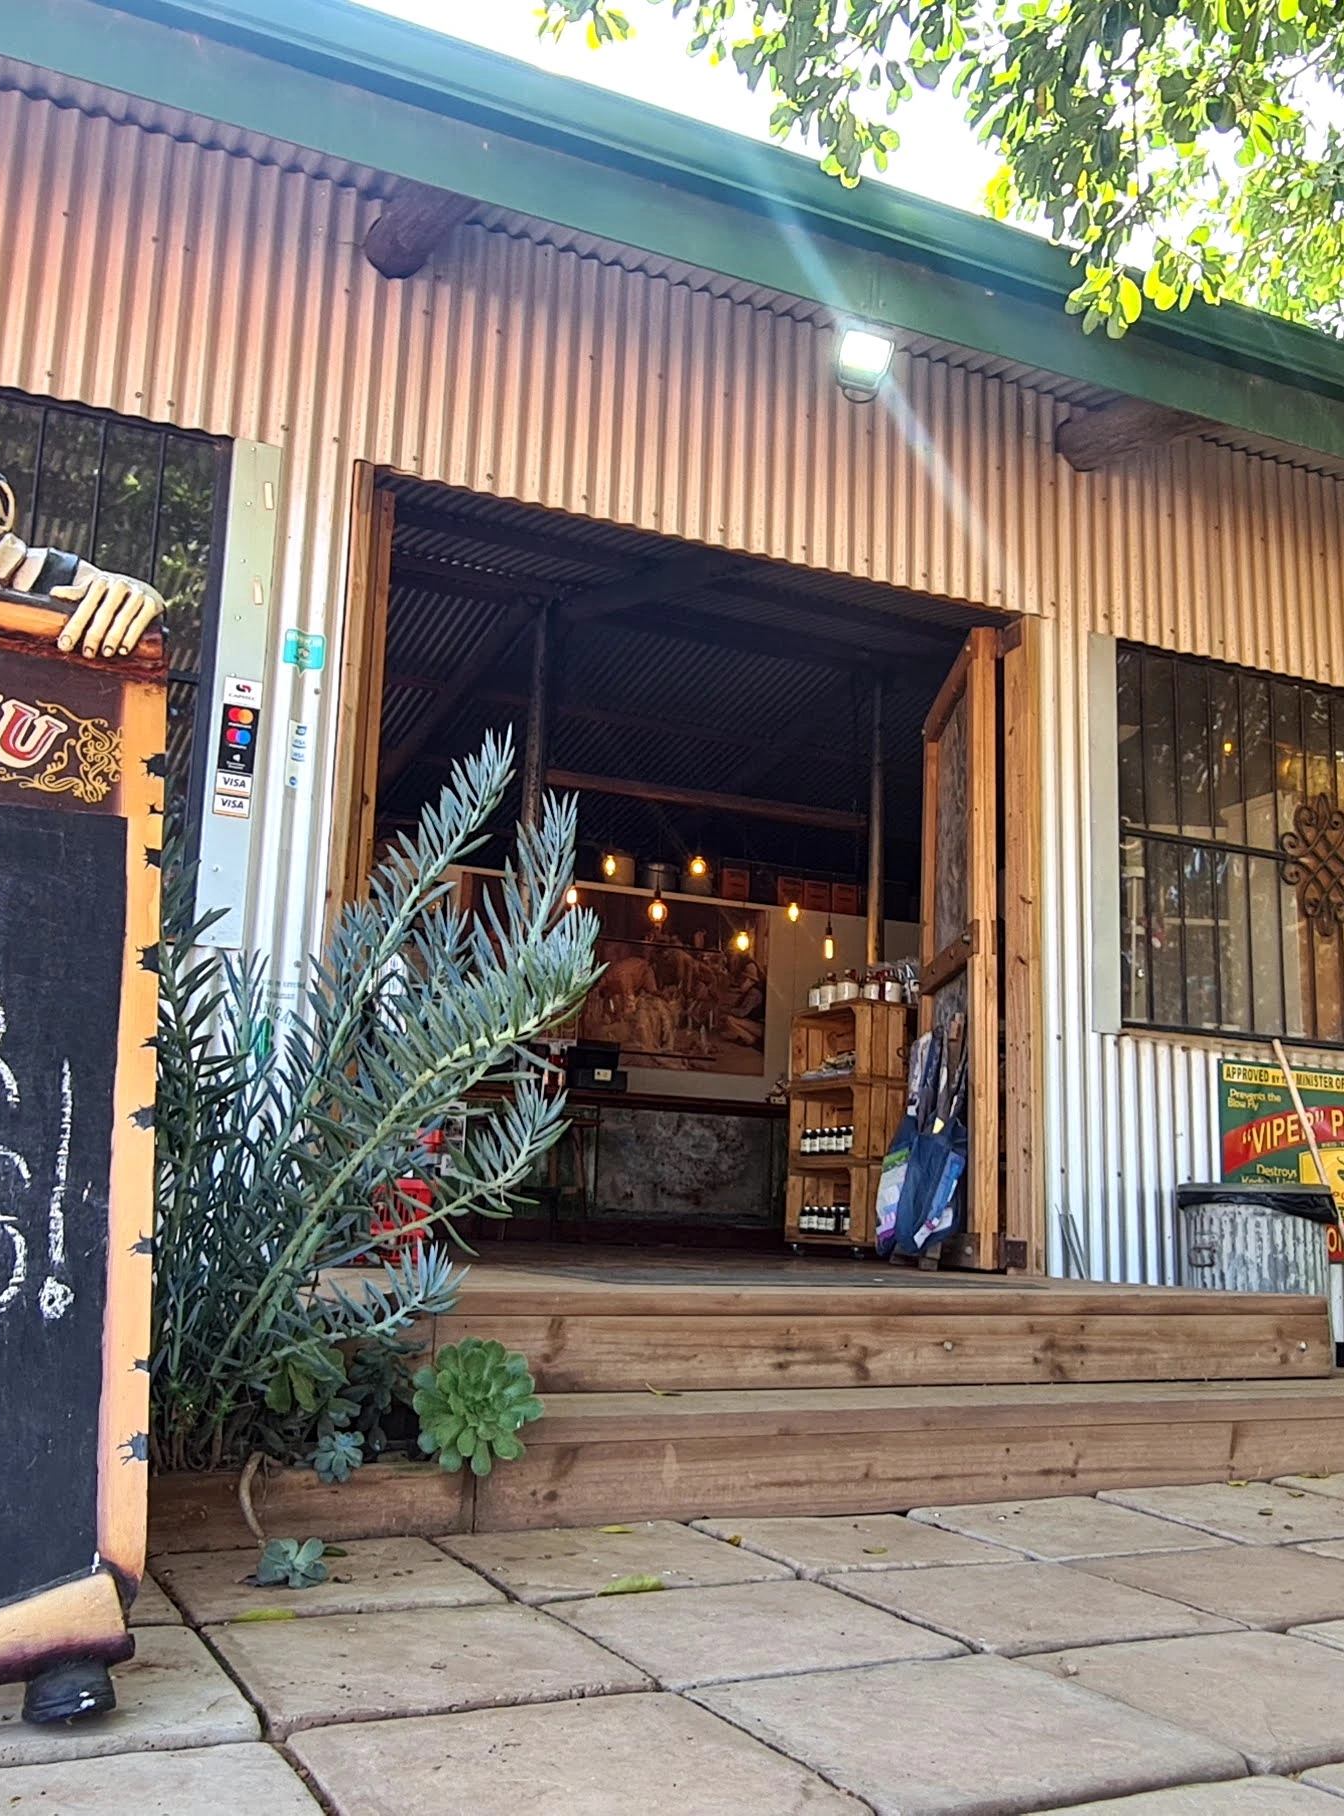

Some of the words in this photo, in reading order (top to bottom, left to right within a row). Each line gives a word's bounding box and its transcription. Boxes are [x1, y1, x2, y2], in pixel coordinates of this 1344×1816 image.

[223, 776, 246, 788] VISA
[221, 798, 244, 809] VISA
[1226, 1066, 1269, 1082] APPROVED
[1296, 1073, 1333, 1088] MINISTER
[1335, 1077, 1344, 1089] OF
[1256, 1164, 1297, 1179] Destroys
